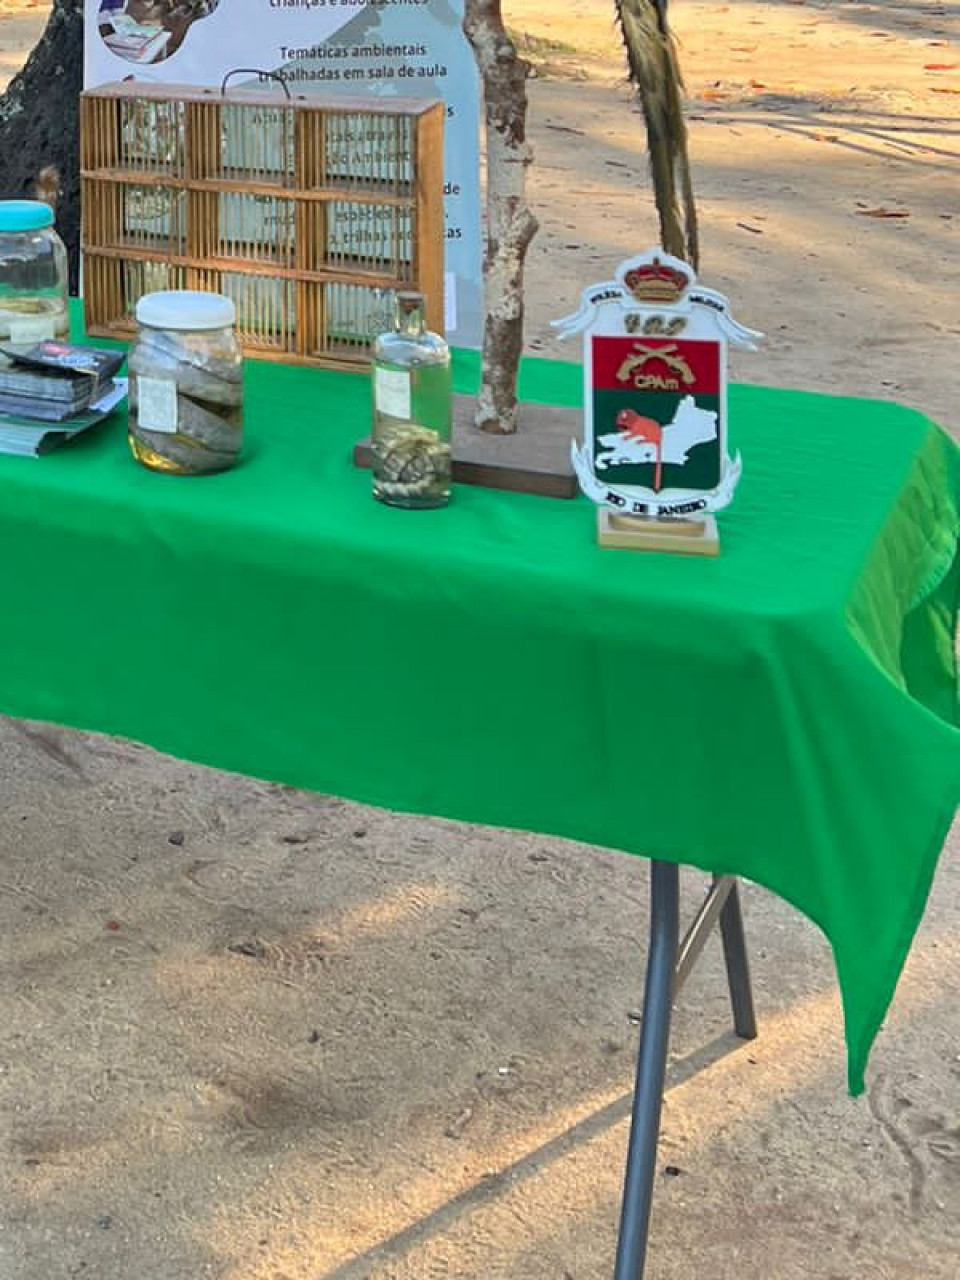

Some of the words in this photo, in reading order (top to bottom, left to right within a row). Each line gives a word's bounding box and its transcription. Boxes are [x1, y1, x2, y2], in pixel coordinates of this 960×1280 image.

[280, 44, 348, 60] Temáticas
[351, 42, 427, 58] ambientais
[258, 66, 340, 82] trabalhadas
[343, 68, 365, 80] em
[368, 65, 395, 79] sala
[398, 64, 416, 78] de
[418, 63, 448, 78] aula
